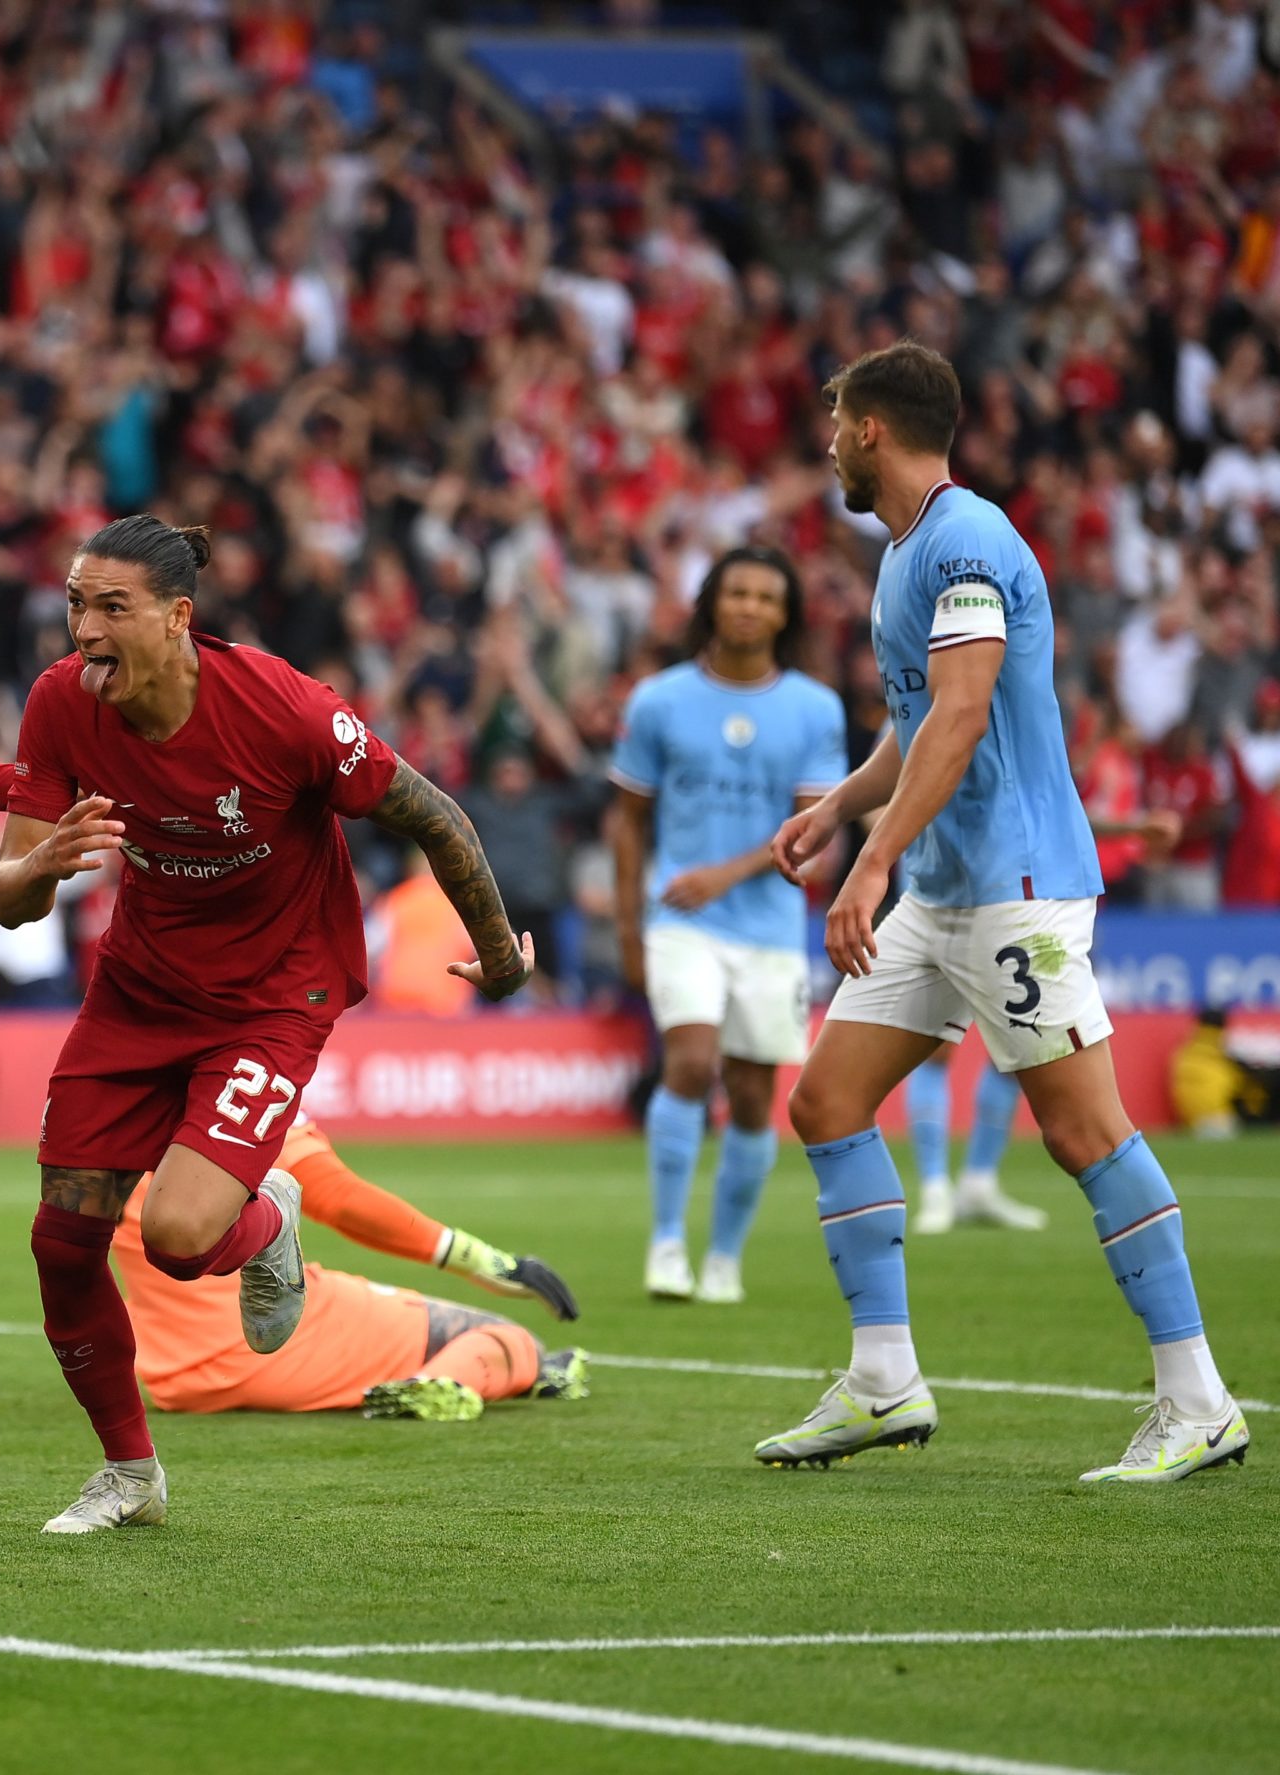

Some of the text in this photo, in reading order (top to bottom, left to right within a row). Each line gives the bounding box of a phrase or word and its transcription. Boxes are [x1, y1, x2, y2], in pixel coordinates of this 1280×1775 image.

[954, 597, 1004, 610] RESPEC
[995, 946, 1041, 1015] 3
[215, 1057, 297, 1142] 27
